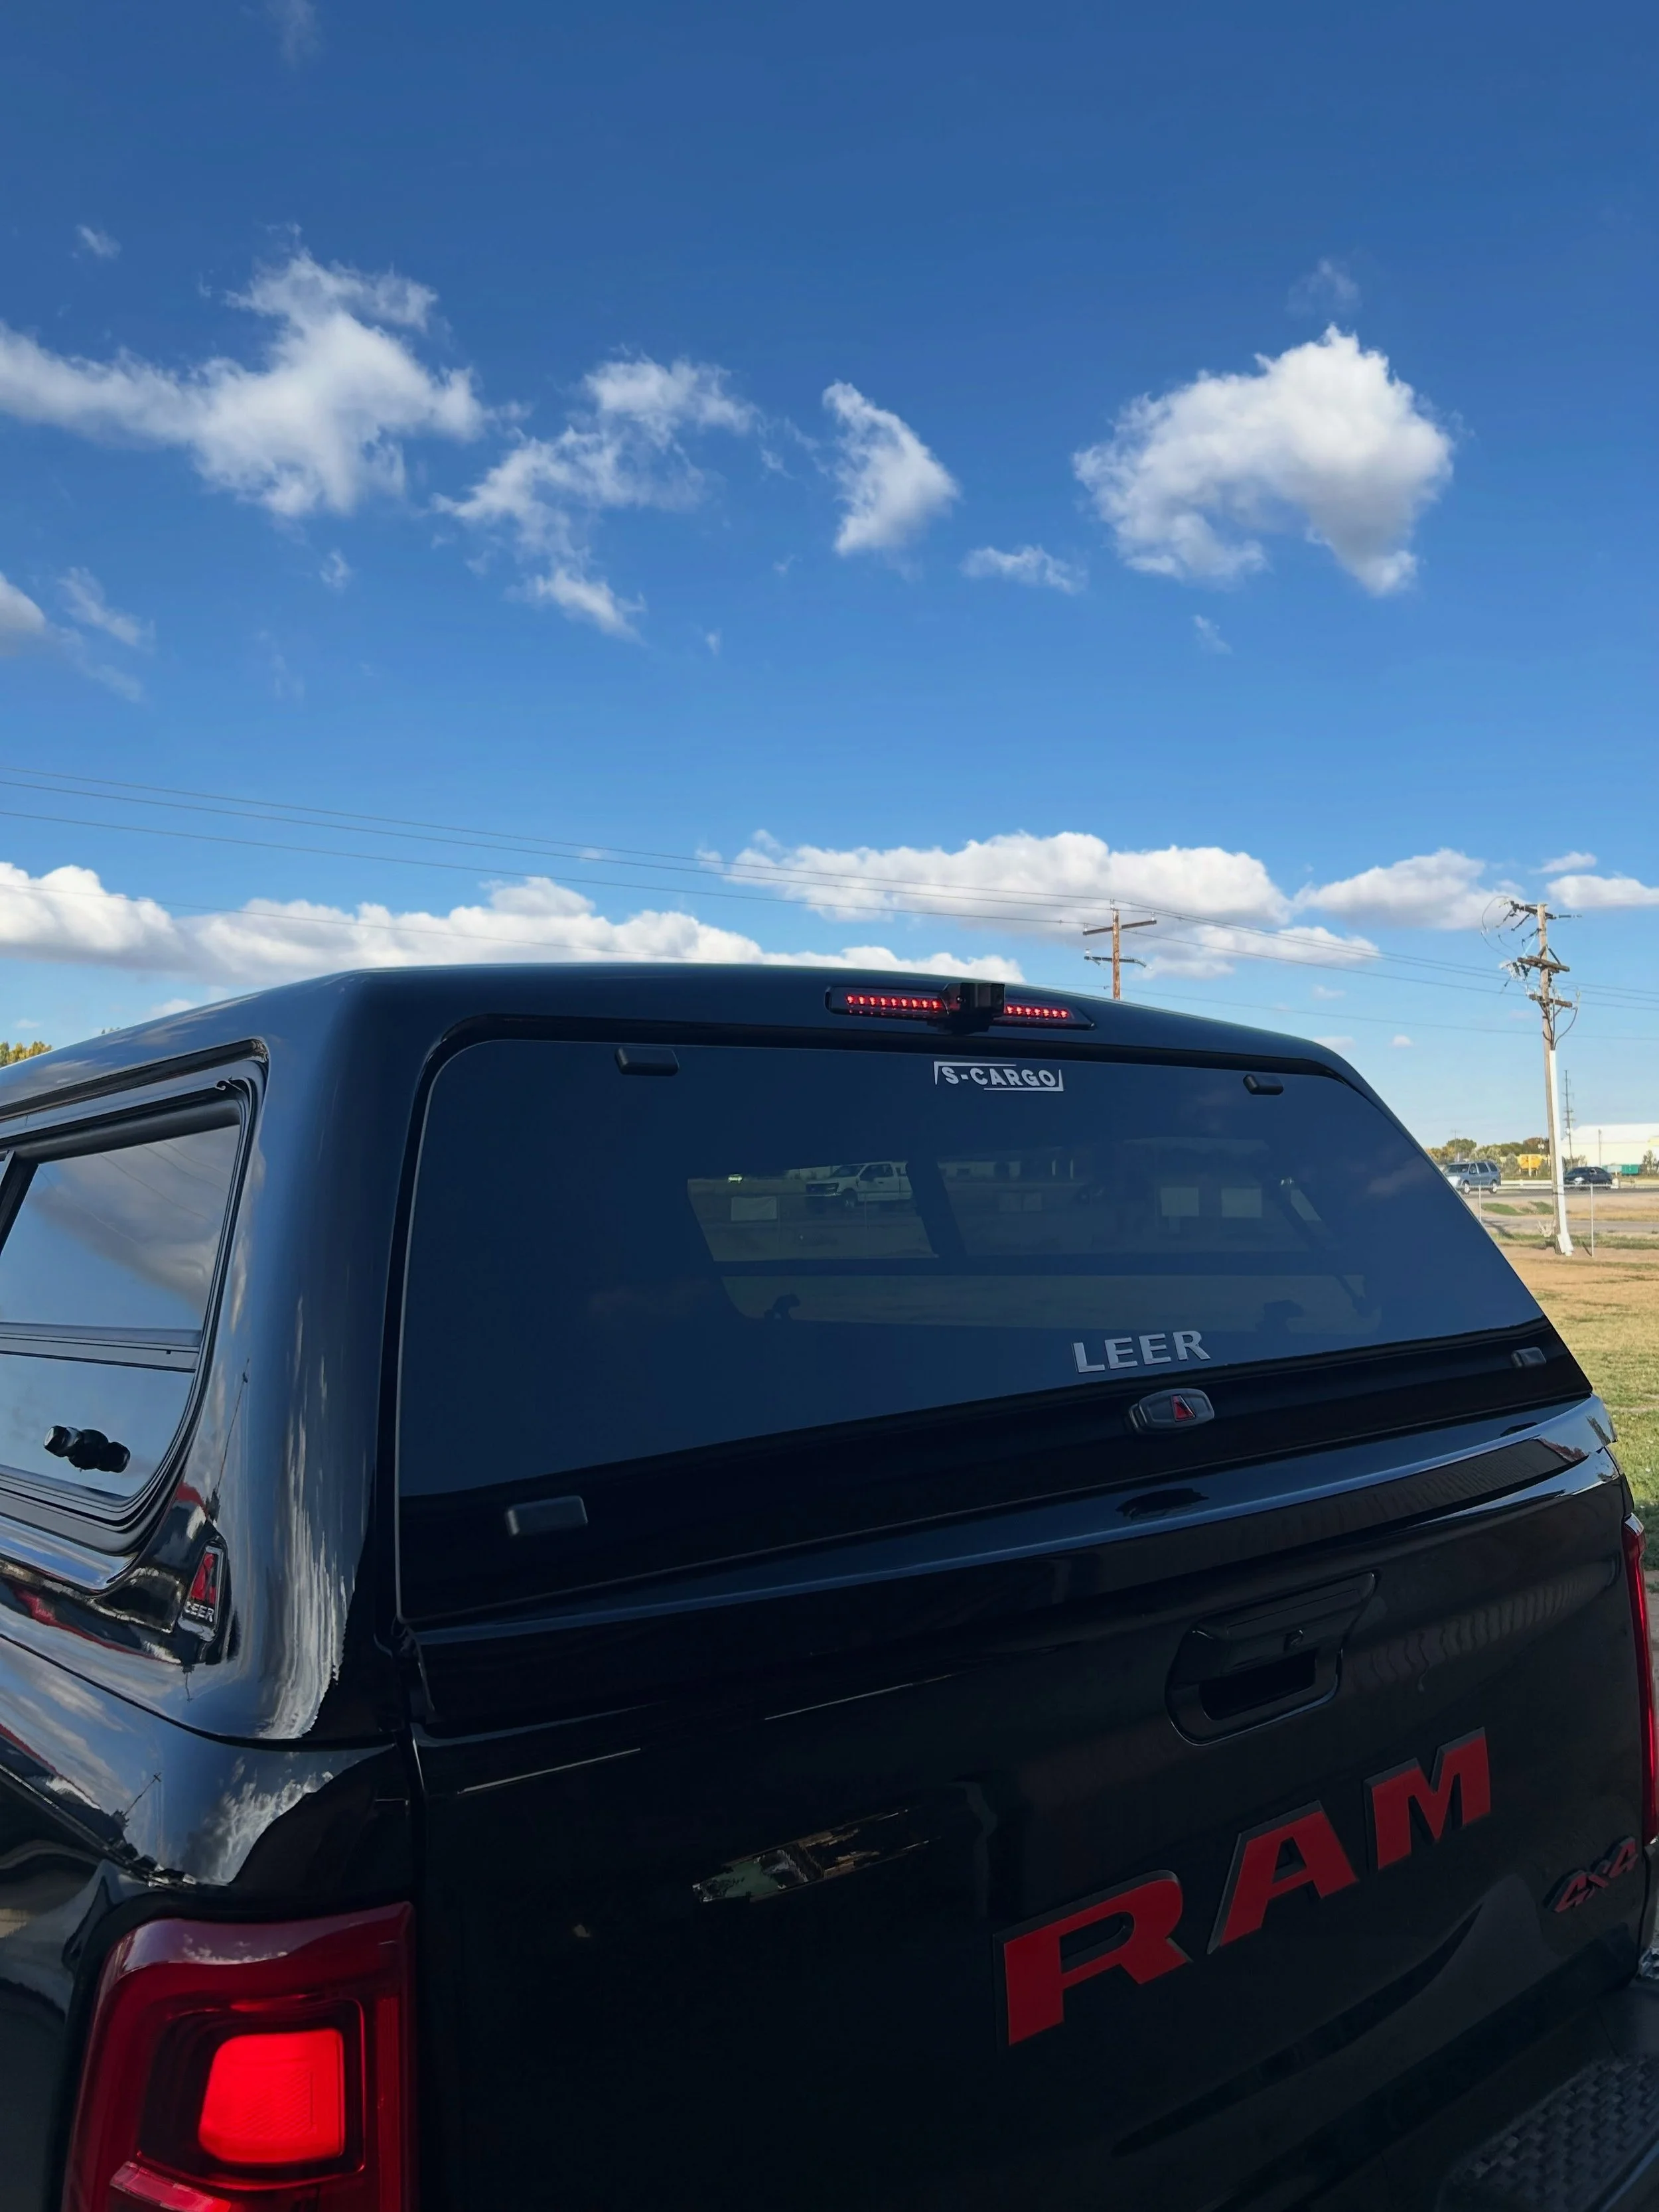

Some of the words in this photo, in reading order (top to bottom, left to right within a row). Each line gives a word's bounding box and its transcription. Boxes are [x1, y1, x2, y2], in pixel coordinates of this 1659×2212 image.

[942, 1067, 1056, 1087] S-CARGO
[1072, 1330, 1211, 1373] LEER
[184, 1601, 214, 1623] LEER
[994, 1726, 1491, 2046] RAM
